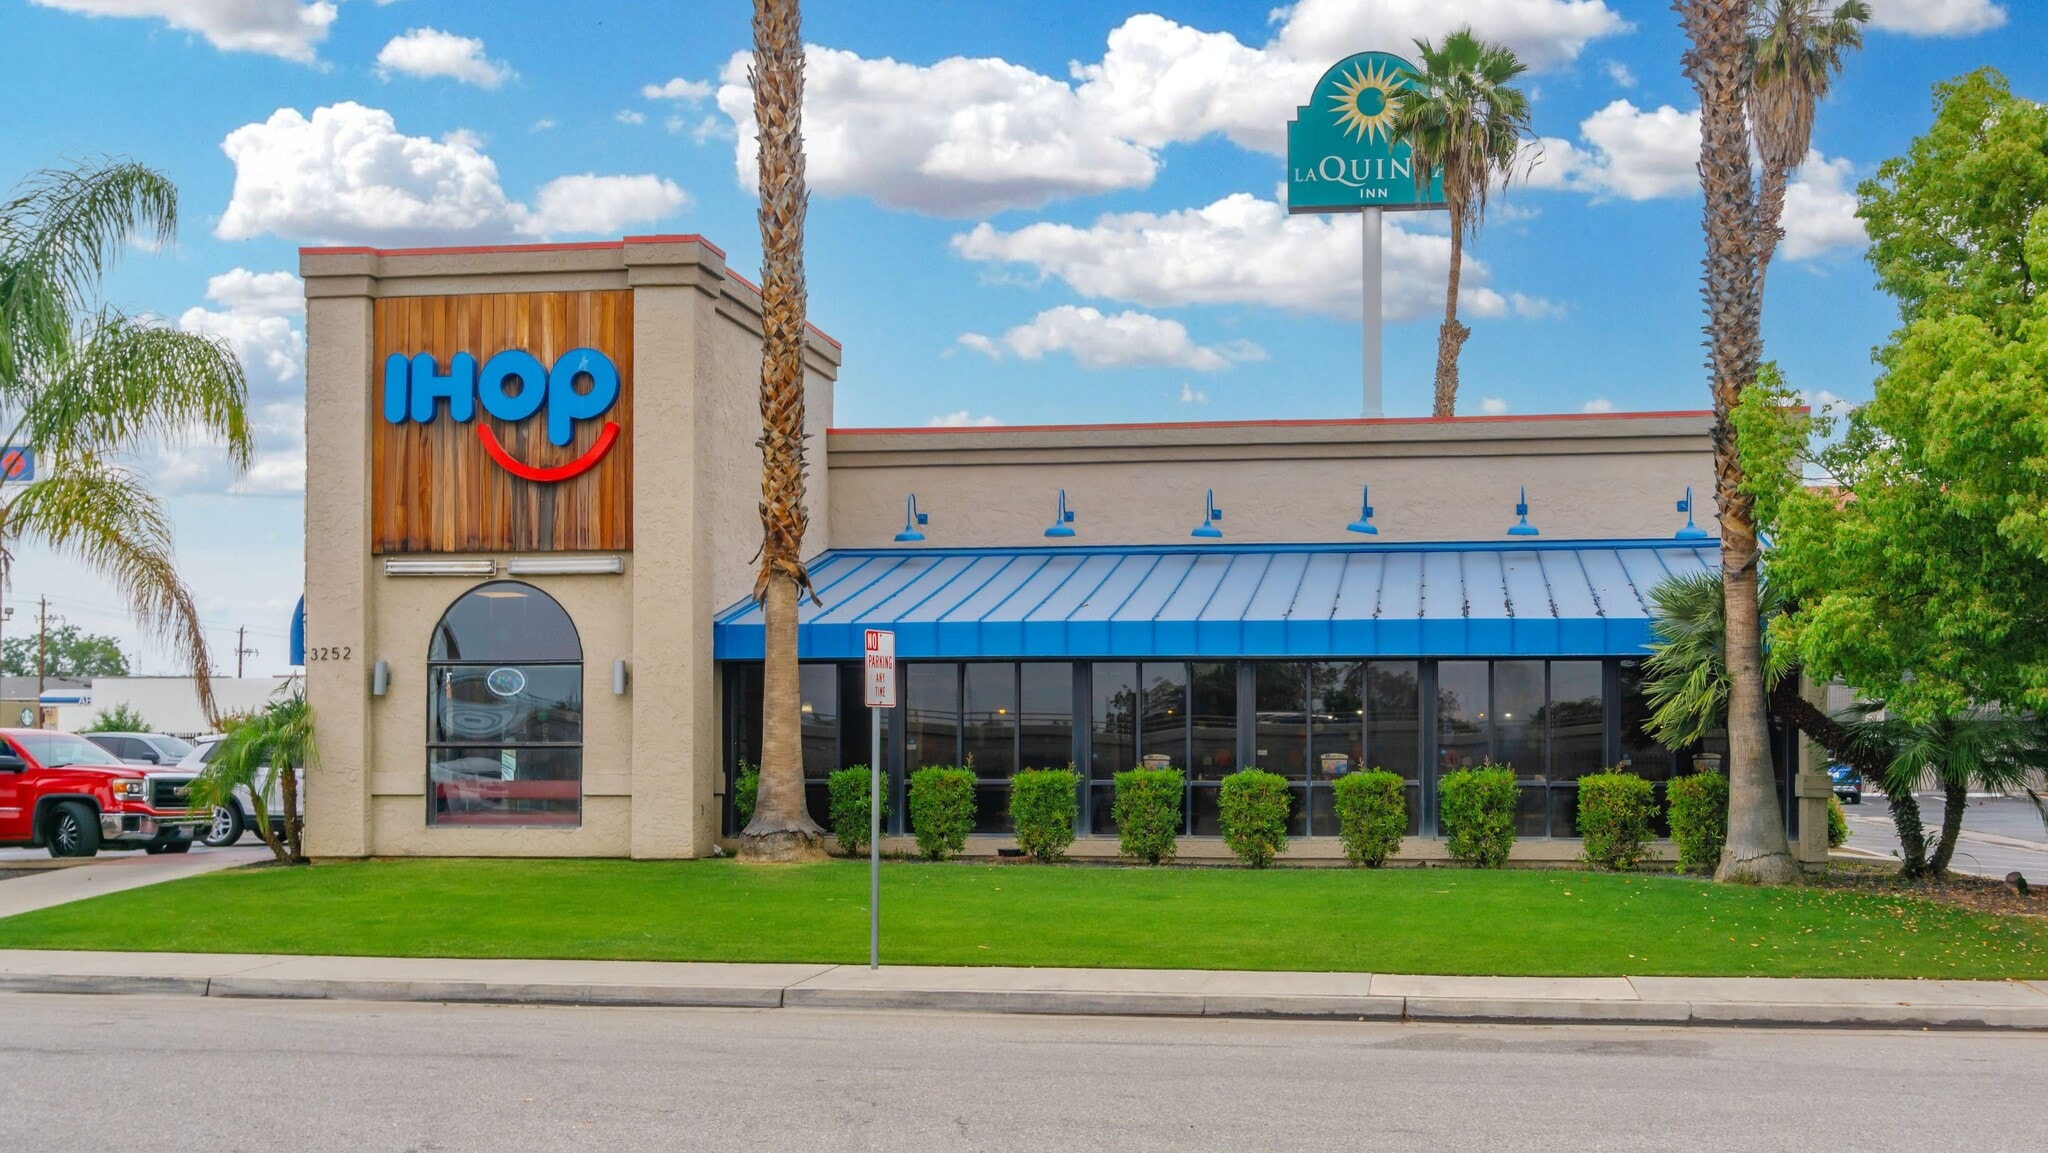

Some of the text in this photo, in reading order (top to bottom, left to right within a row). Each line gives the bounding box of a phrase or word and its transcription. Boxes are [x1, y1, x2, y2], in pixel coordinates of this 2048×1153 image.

[1294, 155, 1444, 187] LA QUIN
[1360, 188, 1388, 199] INN
[867, 632, 877, 650] NO
[310, 646, 351, 661] 3252
[868, 654, 893, 670] PARKING
[875, 673, 885, 683] ANY
[875, 686, 886, 697] TIME
